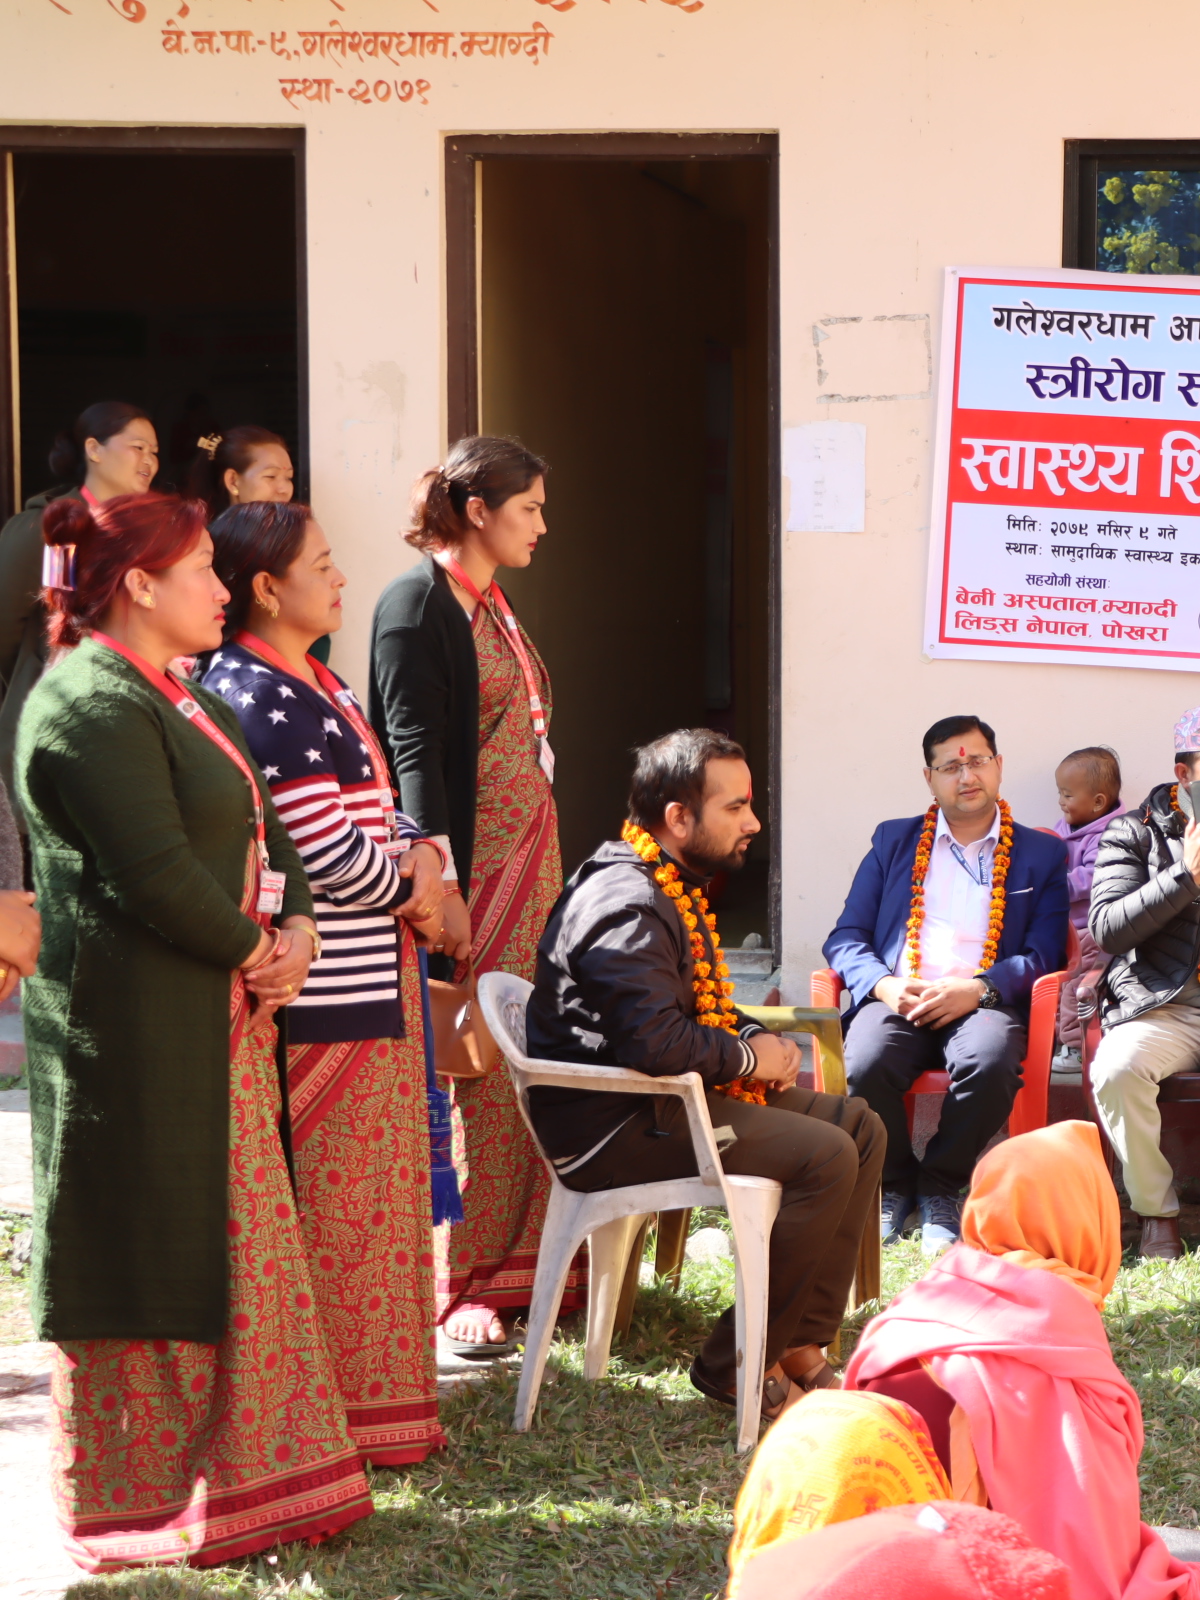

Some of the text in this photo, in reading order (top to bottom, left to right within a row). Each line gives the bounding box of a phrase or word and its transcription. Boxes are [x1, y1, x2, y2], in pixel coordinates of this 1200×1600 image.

[992, 301, 1155, 341] गलेश्वरधाम
[1026, 356, 1165, 402] स्त्रीरोग
[961, 437, 1144, 496] स्वास्थ्य
[1051, 521, 1088, 537] २०७९
[1139, 526, 1149, 540] ९
[1158, 525, 1178, 540] गते
[1051, 543, 1118, 562] सामुदायिक
[1125, 549, 1173, 564] स्वास्थ्य
[1026, 572, 1071, 587] सहयोगी
[955, 586, 996, 607] बेनी
[1102, 620, 1169, 642] पोखरा
